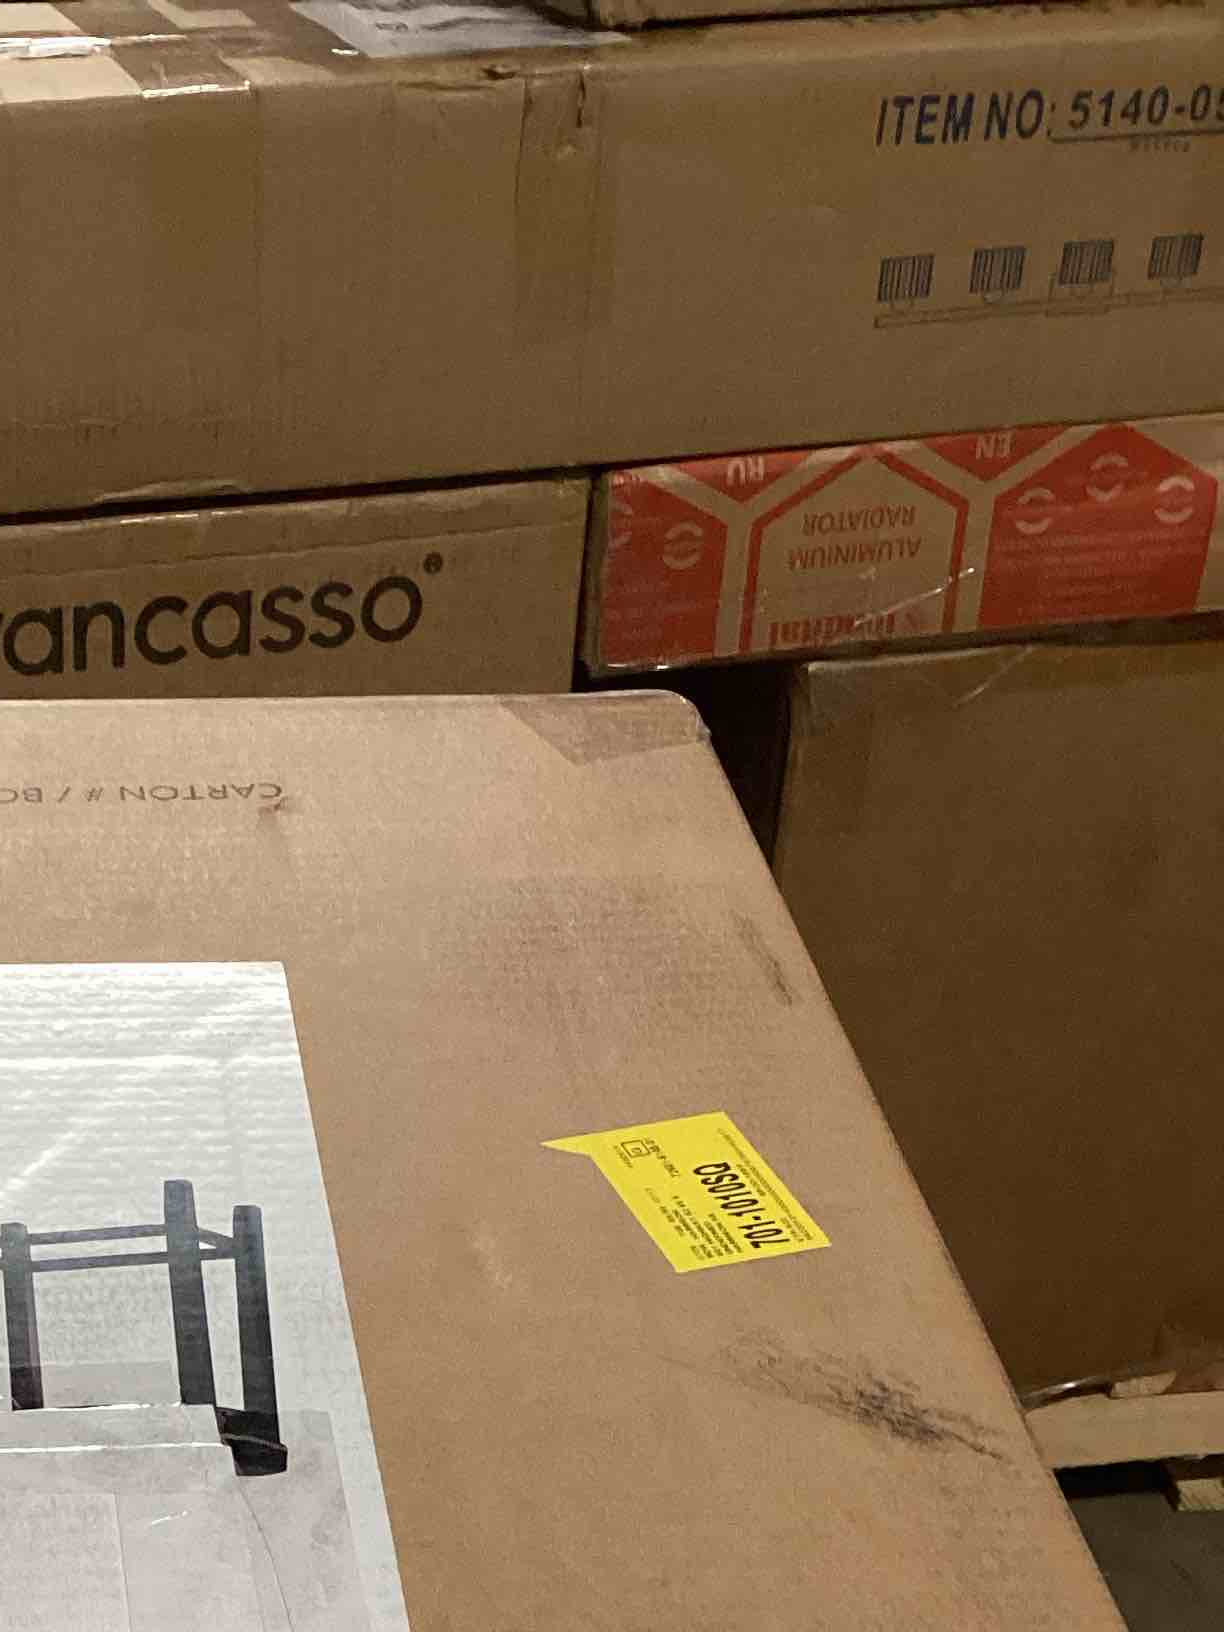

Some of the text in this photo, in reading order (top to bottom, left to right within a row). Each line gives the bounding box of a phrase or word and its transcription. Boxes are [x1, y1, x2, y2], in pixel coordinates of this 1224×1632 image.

[875, 92, 975, 147] ITEM
[799, 503, 917, 537] RADIATOR
[786, 535, 922, 572] ALUMINIUM
[119, 782, 283, 803] CARTON
